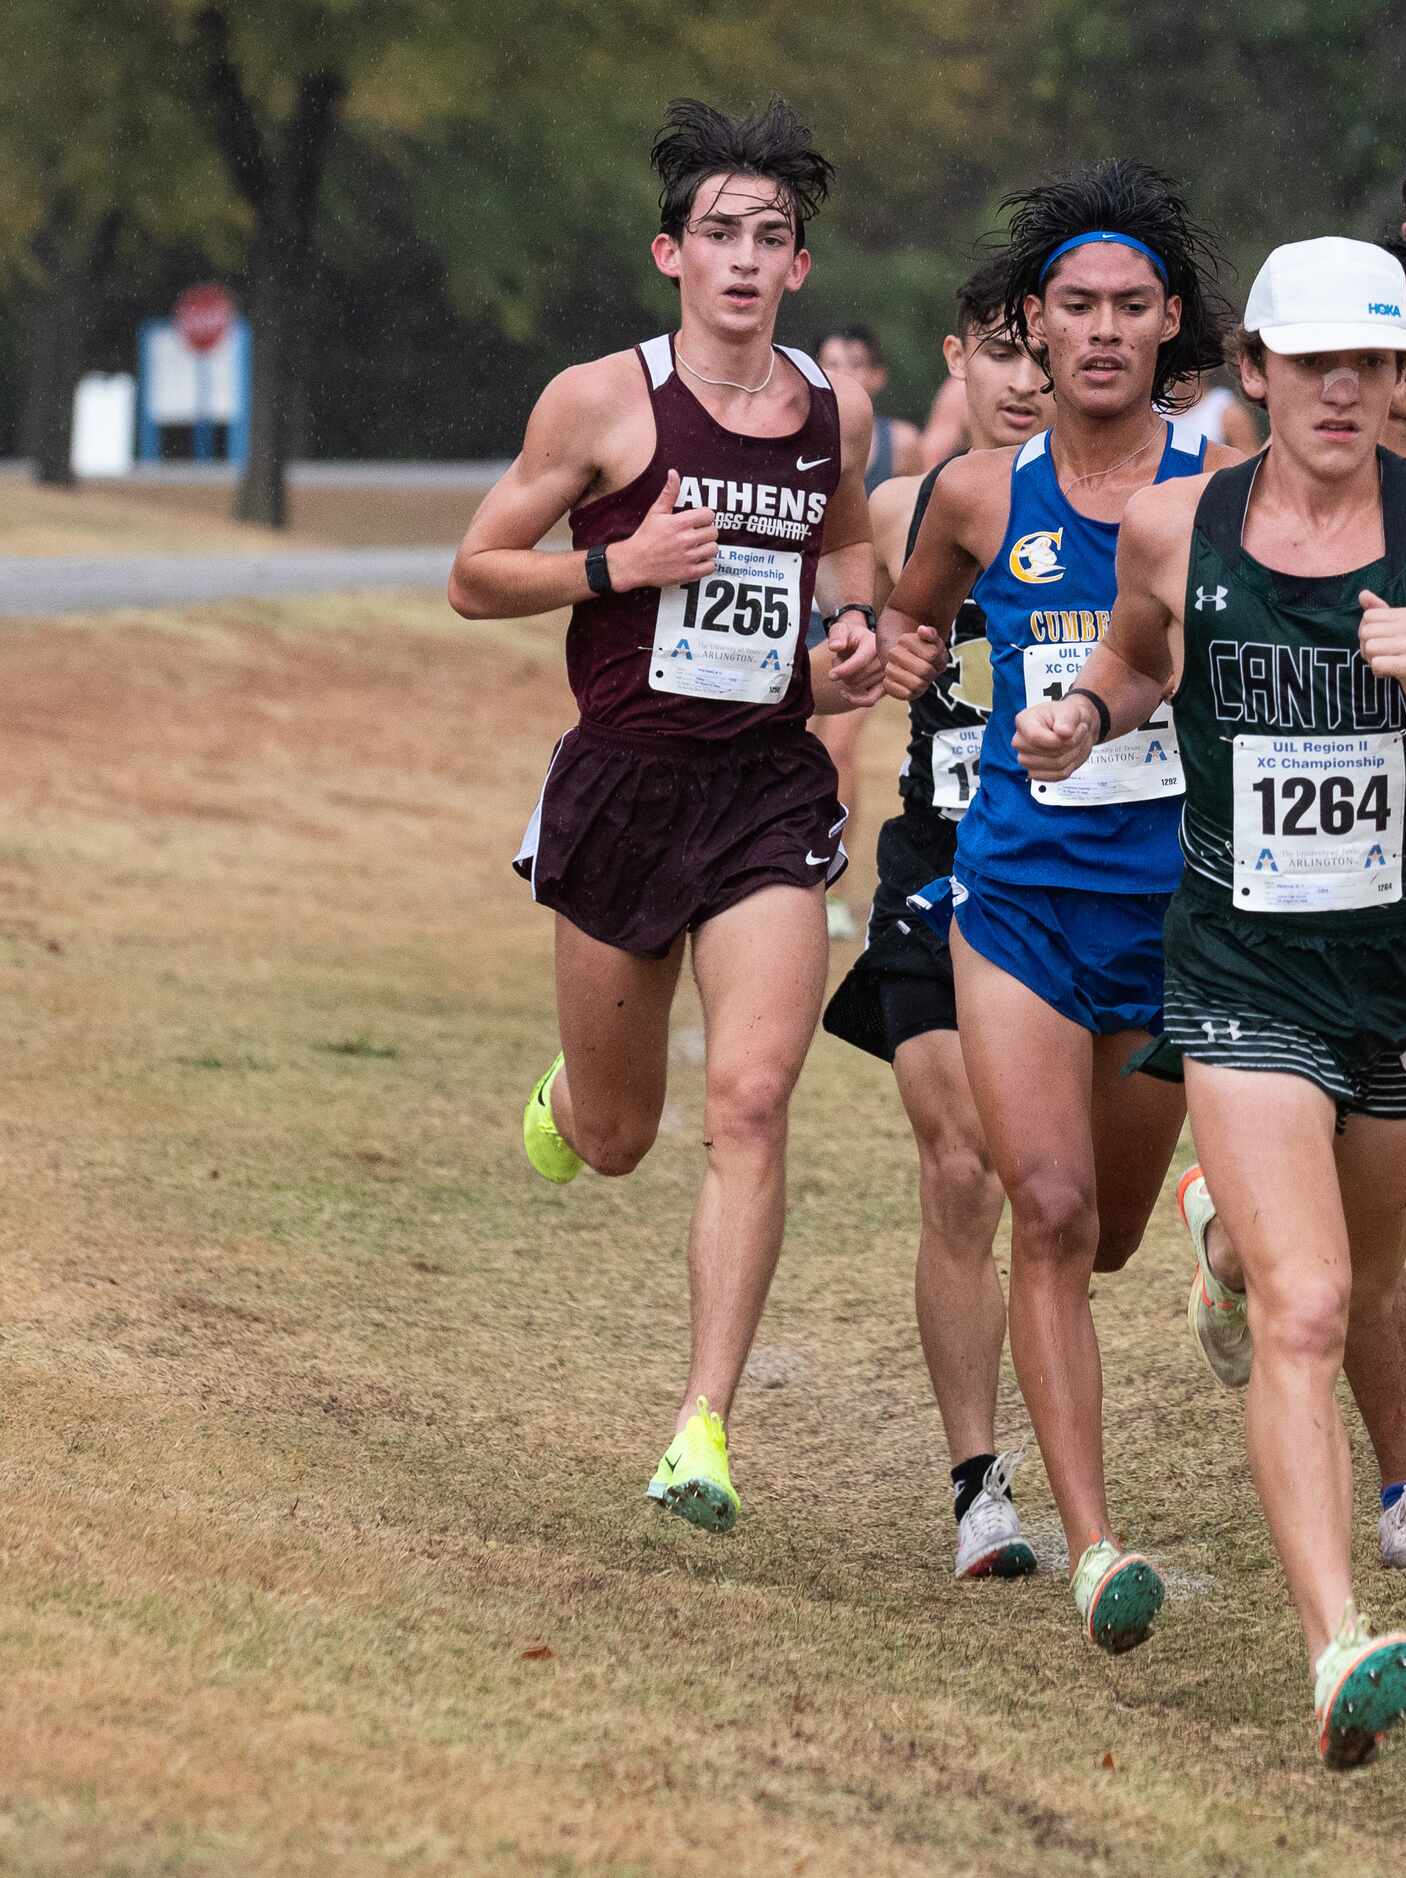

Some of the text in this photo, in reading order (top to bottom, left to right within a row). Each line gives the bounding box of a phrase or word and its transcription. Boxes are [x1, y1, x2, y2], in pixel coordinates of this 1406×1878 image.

[1368, 303, 1401, 318] HOKA
[674, 476, 827, 524] ATHENS
[714, 512, 810, 541] OSS COUNTRY
[729, 551, 765, 564] Region
[680, 579, 789, 639] 1255
[1030, 610, 1112, 642] CUMBE
[1059, 648, 1081, 658] UIL
[1045, 663, 1063, 673] XC
[960, 731, 978, 740] UIL
[1273, 741, 1368, 754] UIL Region II
[1257, 756, 1385, 770] XC Championship
[1252, 774, 1391, 837] 1264
[1288, 858, 1353, 869] ARLINGTON
